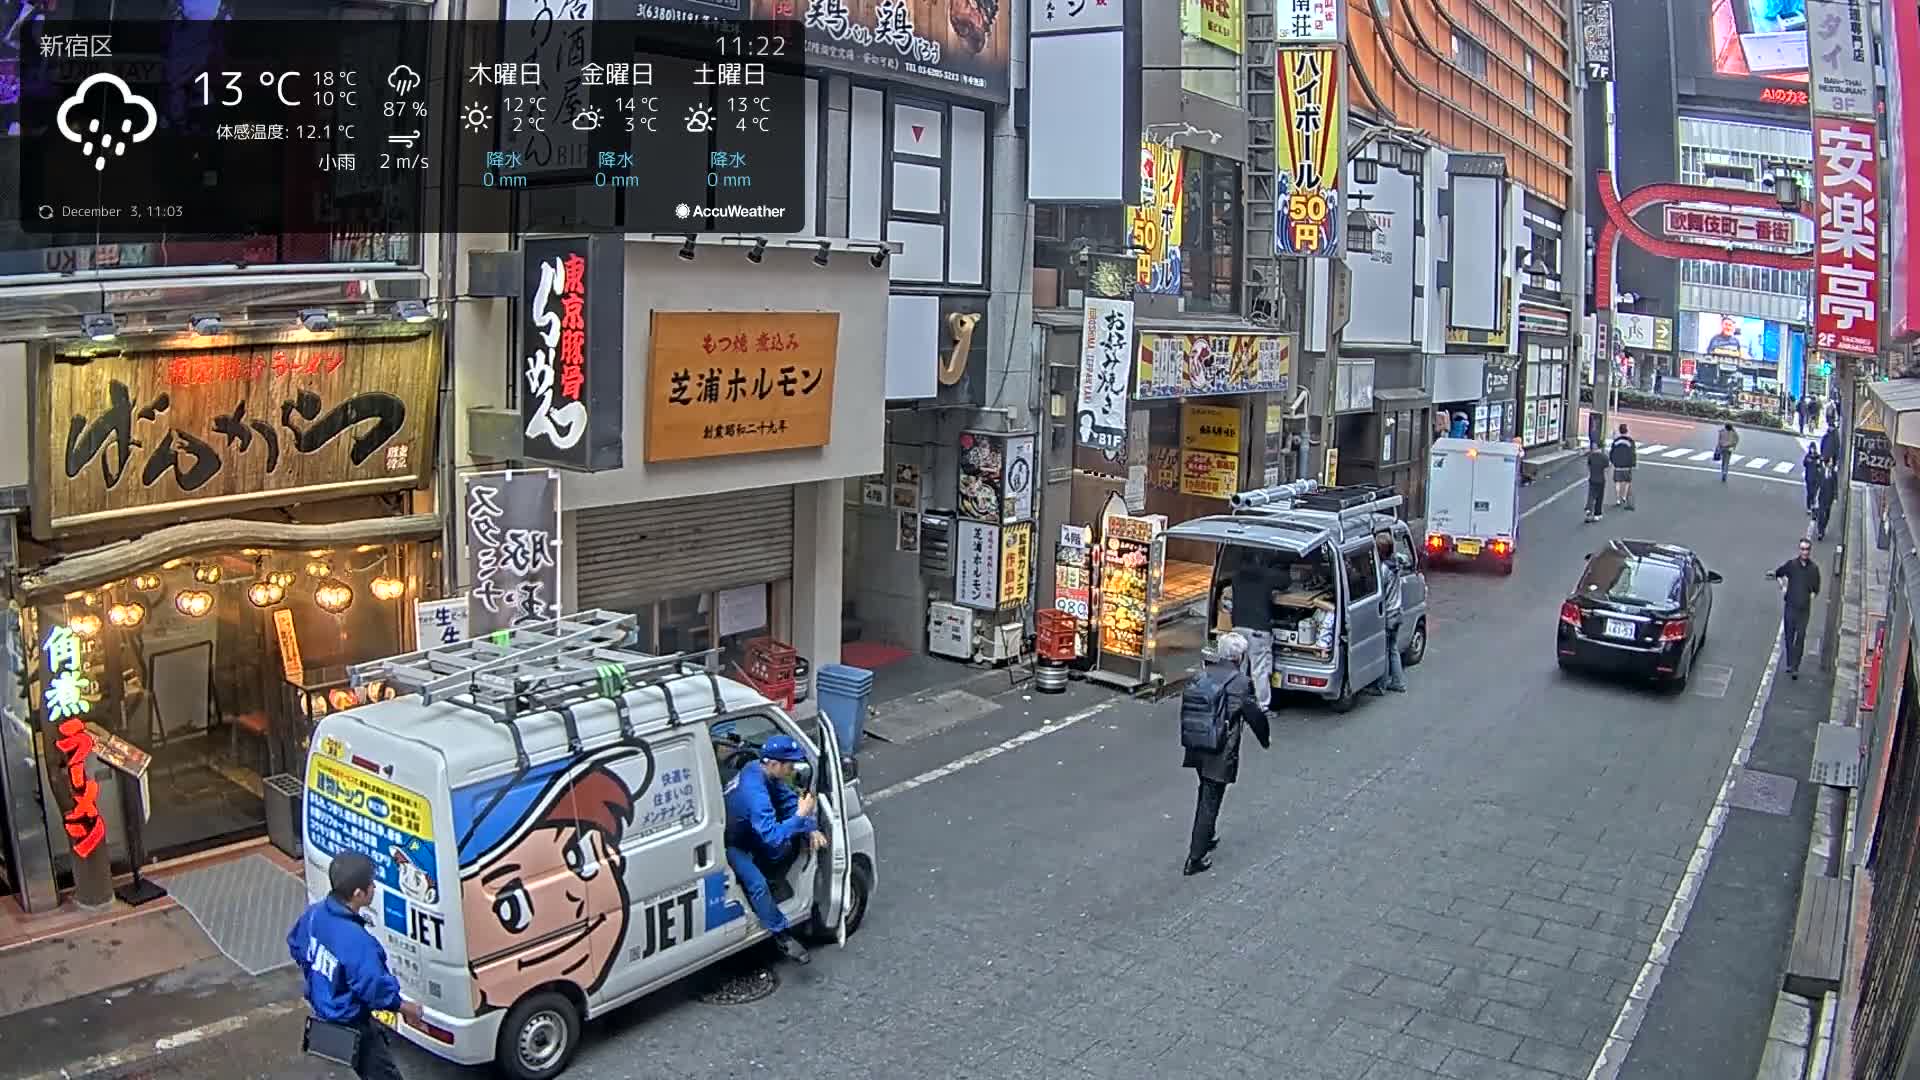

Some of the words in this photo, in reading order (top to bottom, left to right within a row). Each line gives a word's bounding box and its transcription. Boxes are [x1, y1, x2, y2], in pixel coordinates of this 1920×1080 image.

[1818, 14, 1842, 70] タイ
[1589, 63, 1609, 78] 7F
[1296, 53, 1320, 190] ハイボール
[1669, 210, 1791, 242] 歌舞伎町一番街
[1819, 126, 1875, 332] 安楽亭
[561, 252, 586, 401] 東京豚骨
[703, 333, 748, 354] もつ焼
[756, 332, 800, 352] 煮込み
[1817, 332, 1838, 348] 2F
[1097, 309, 1127, 416] お好み焼き
[669, 366, 823, 405] 芝浦ホルモン
[65, 380, 407, 494] ばんから
[703, 419, 789, 439] 創業昭和二十九年
[1099, 433, 1121, 448] B1F
[972, 527, 983, 601] 芝浦ホルモン
[56, 717, 106, 858] ラーメン
[654, 784, 693, 808] 住まいの
[641, 798, 696, 827] メンテナンス
[410, 907, 446, 951] JET
[642, 889, 698, 959] JET
[311, 943, 338, 982] JET
